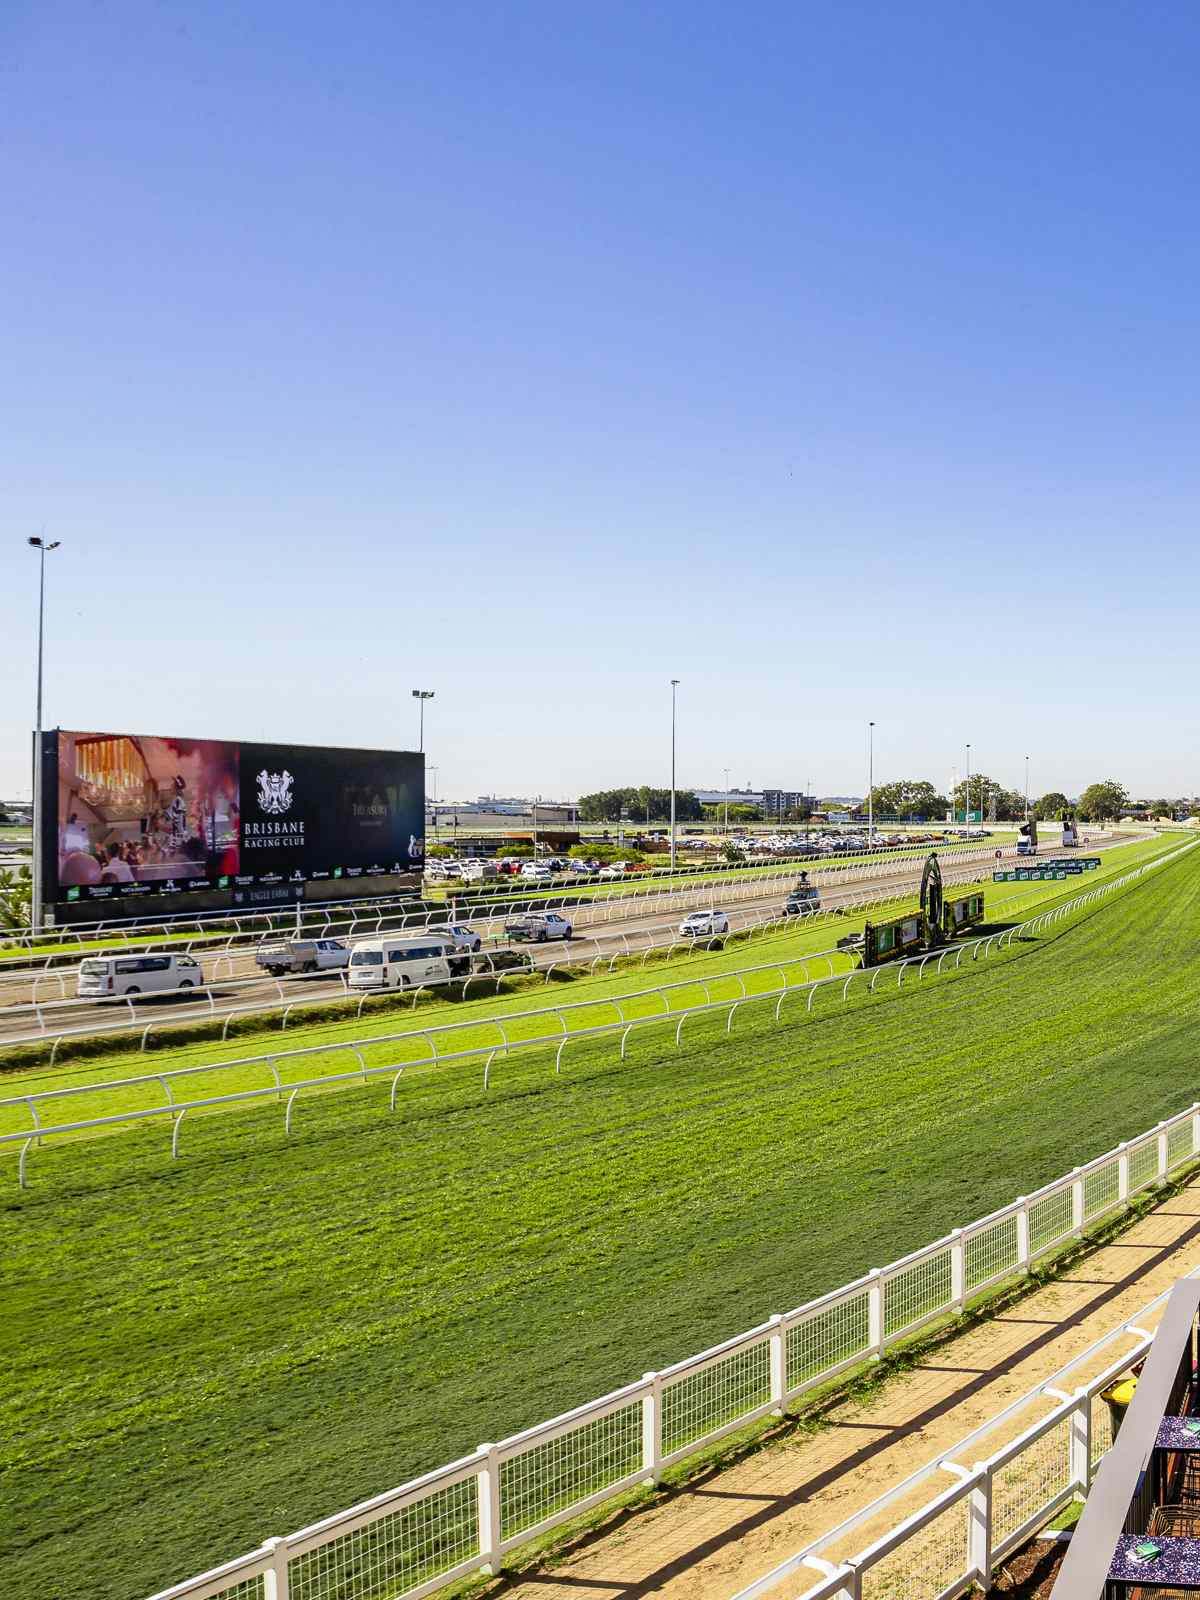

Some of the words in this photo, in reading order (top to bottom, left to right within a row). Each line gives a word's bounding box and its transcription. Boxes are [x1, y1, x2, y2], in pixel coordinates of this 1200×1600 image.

[245, 821, 305, 835] BRISBANE
[244, 838, 281, 848] RACING
[283, 837, 305, 847] CLUB
